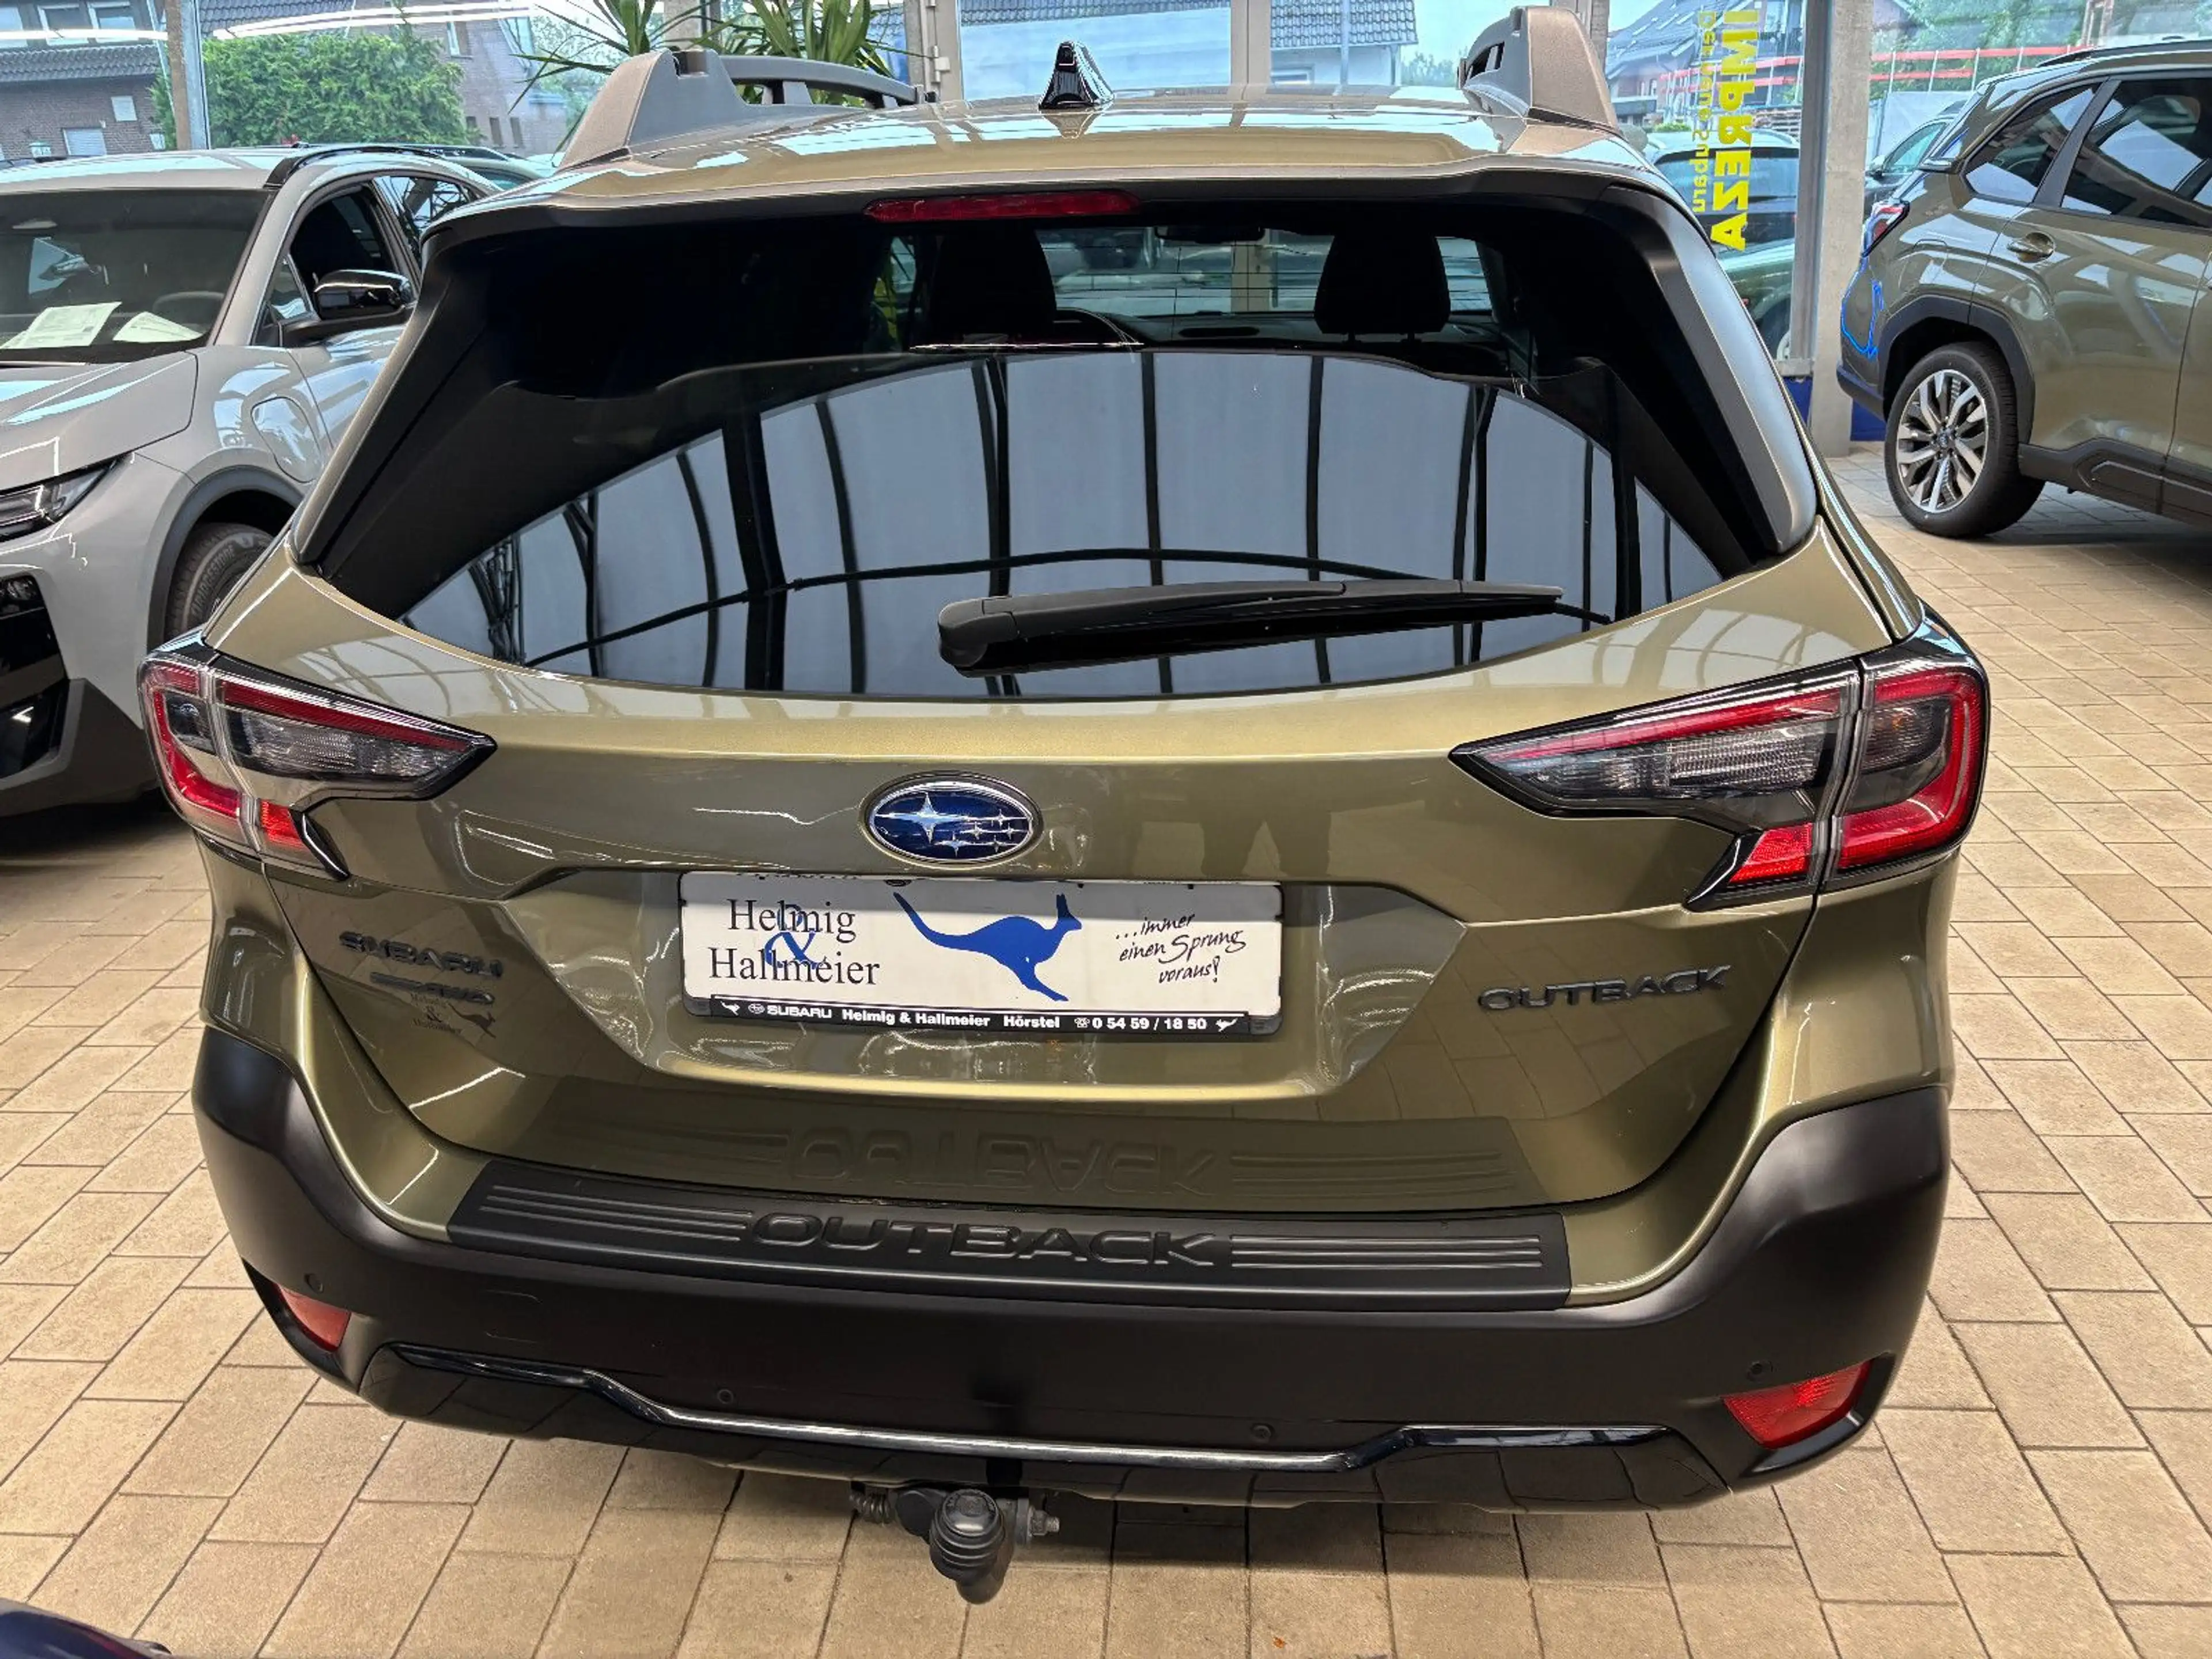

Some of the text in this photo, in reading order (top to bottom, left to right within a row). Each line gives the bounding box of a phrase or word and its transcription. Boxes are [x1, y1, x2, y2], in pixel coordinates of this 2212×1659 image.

[726, 899, 857, 944] Helmig
[763, 903, 827, 969] &
[708, 946, 880, 985] Hallmeier
[1119, 930, 1247, 964] einen Sprung
[1158, 955, 1221, 983] voraus!
[1478, 965, 1731, 1010] OUTBACK
[767, 1004, 832, 1018] SUBARU
[841, 1008, 896, 1025] Helmig
[899, 1011, 912, 1025] &
[915, 1012, 991, 1027] Hallmeier
[1003, 1014, 1060, 1028] Hörstel
[1092, 1017, 1103, 1029] 0
[1106, 1017, 1127, 1030] 54
[1130, 1017, 1150, 1030] 59
[1164, 1017, 1183, 1030] 18
[1187, 1018, 1207, 1030] 50
[751, 1210, 1218, 1267] OUTBACK
